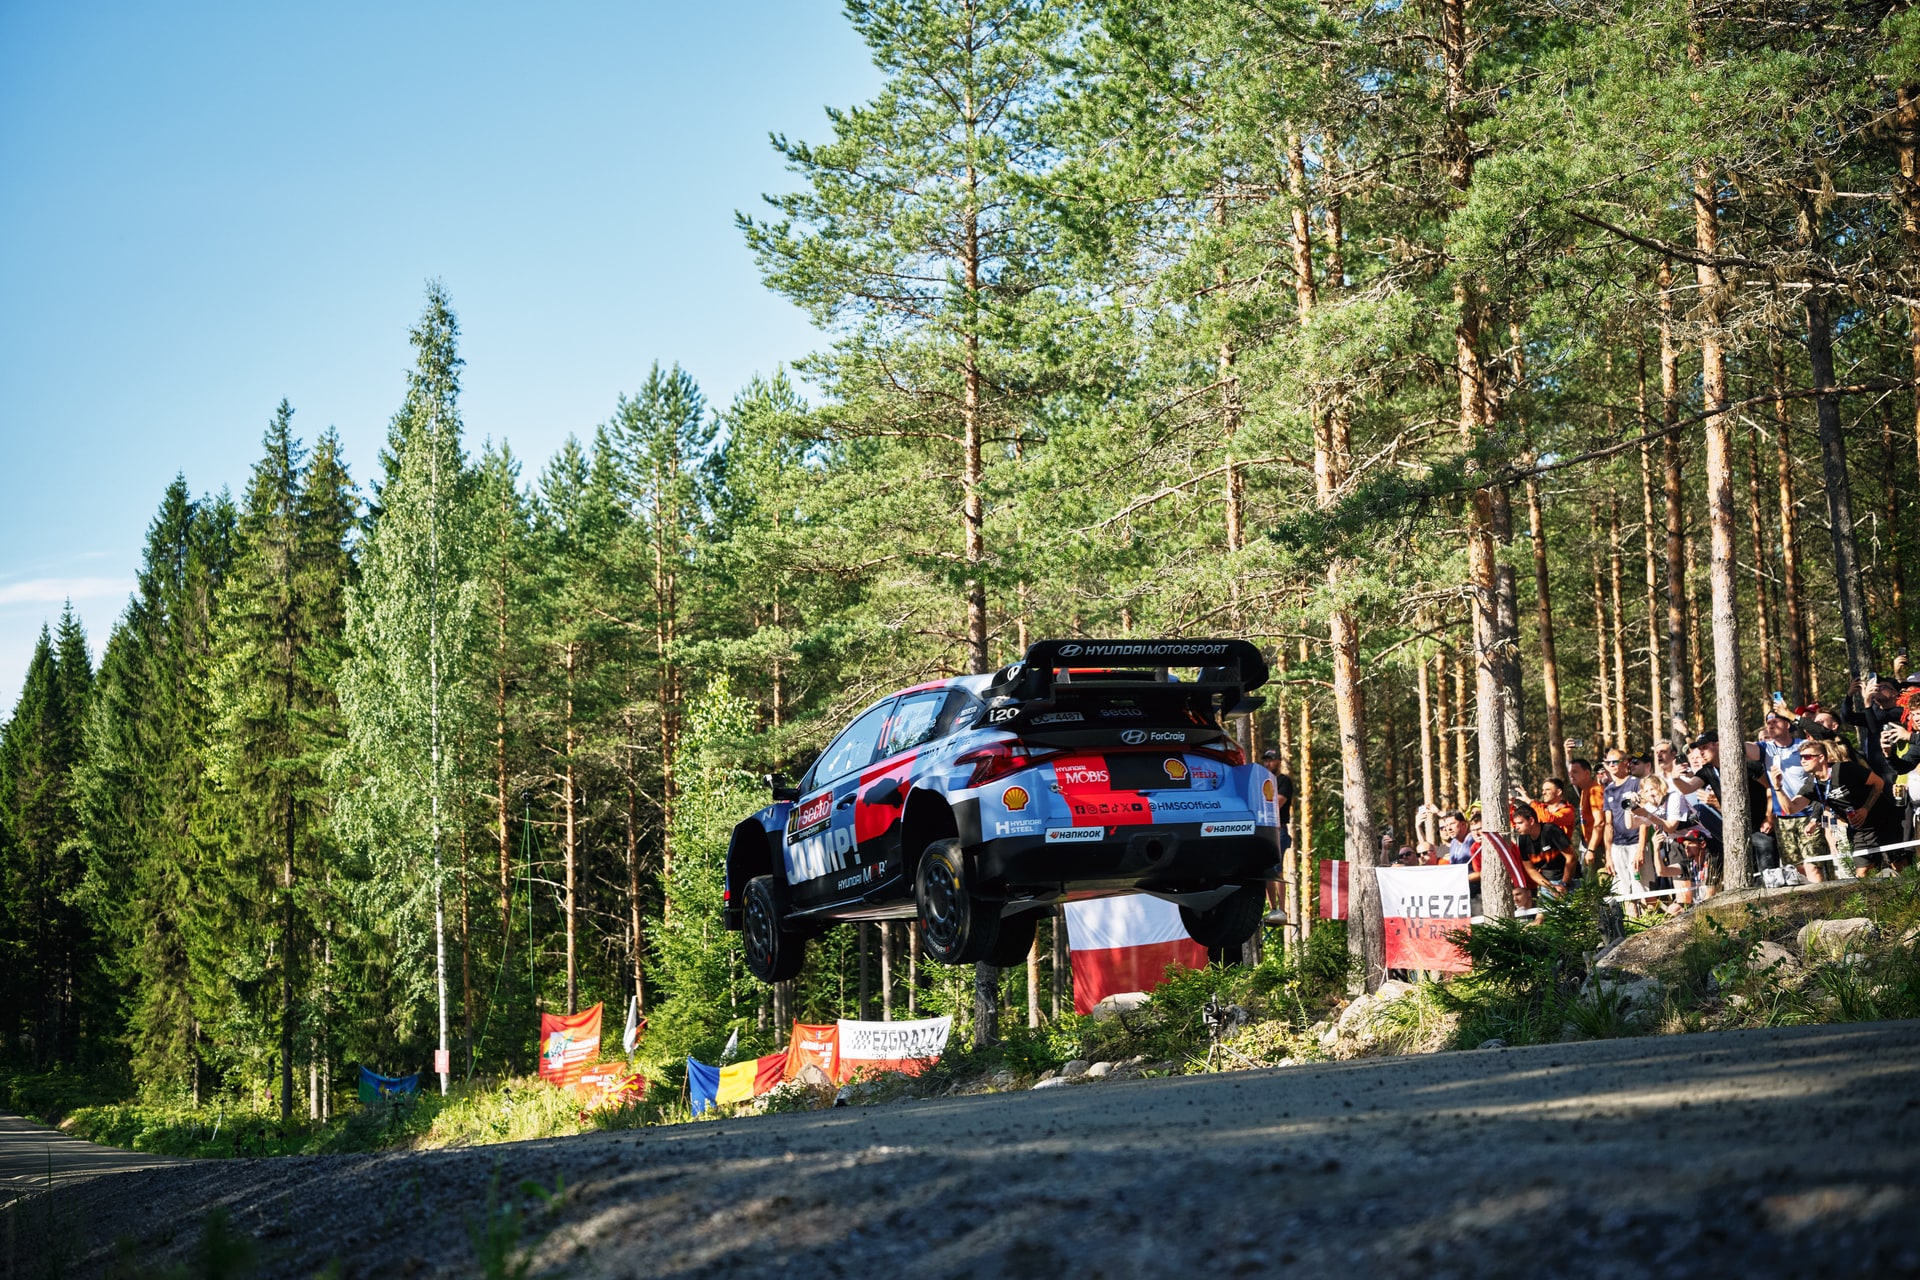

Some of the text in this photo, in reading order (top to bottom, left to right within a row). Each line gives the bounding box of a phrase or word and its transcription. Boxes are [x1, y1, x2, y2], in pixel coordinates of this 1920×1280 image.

[1085, 644, 1228, 656] HYUNDAI MOTORSPORT
[989, 707, 1020, 722] i20
[1100, 707, 1142, 717] secto
[1150, 731, 1186, 742] ForCraig
[1055, 765, 1087, 773] HYUNDAI
[1066, 770, 1109, 784] MOBIS
[802, 799, 830, 825] secto
[1149, 801, 1222, 812] @HMSGOfficial
[1010, 819, 1042, 827] HYUNDAI
[1010, 826, 1034, 834] STEEL
[786, 824, 862, 886] JUMP!
